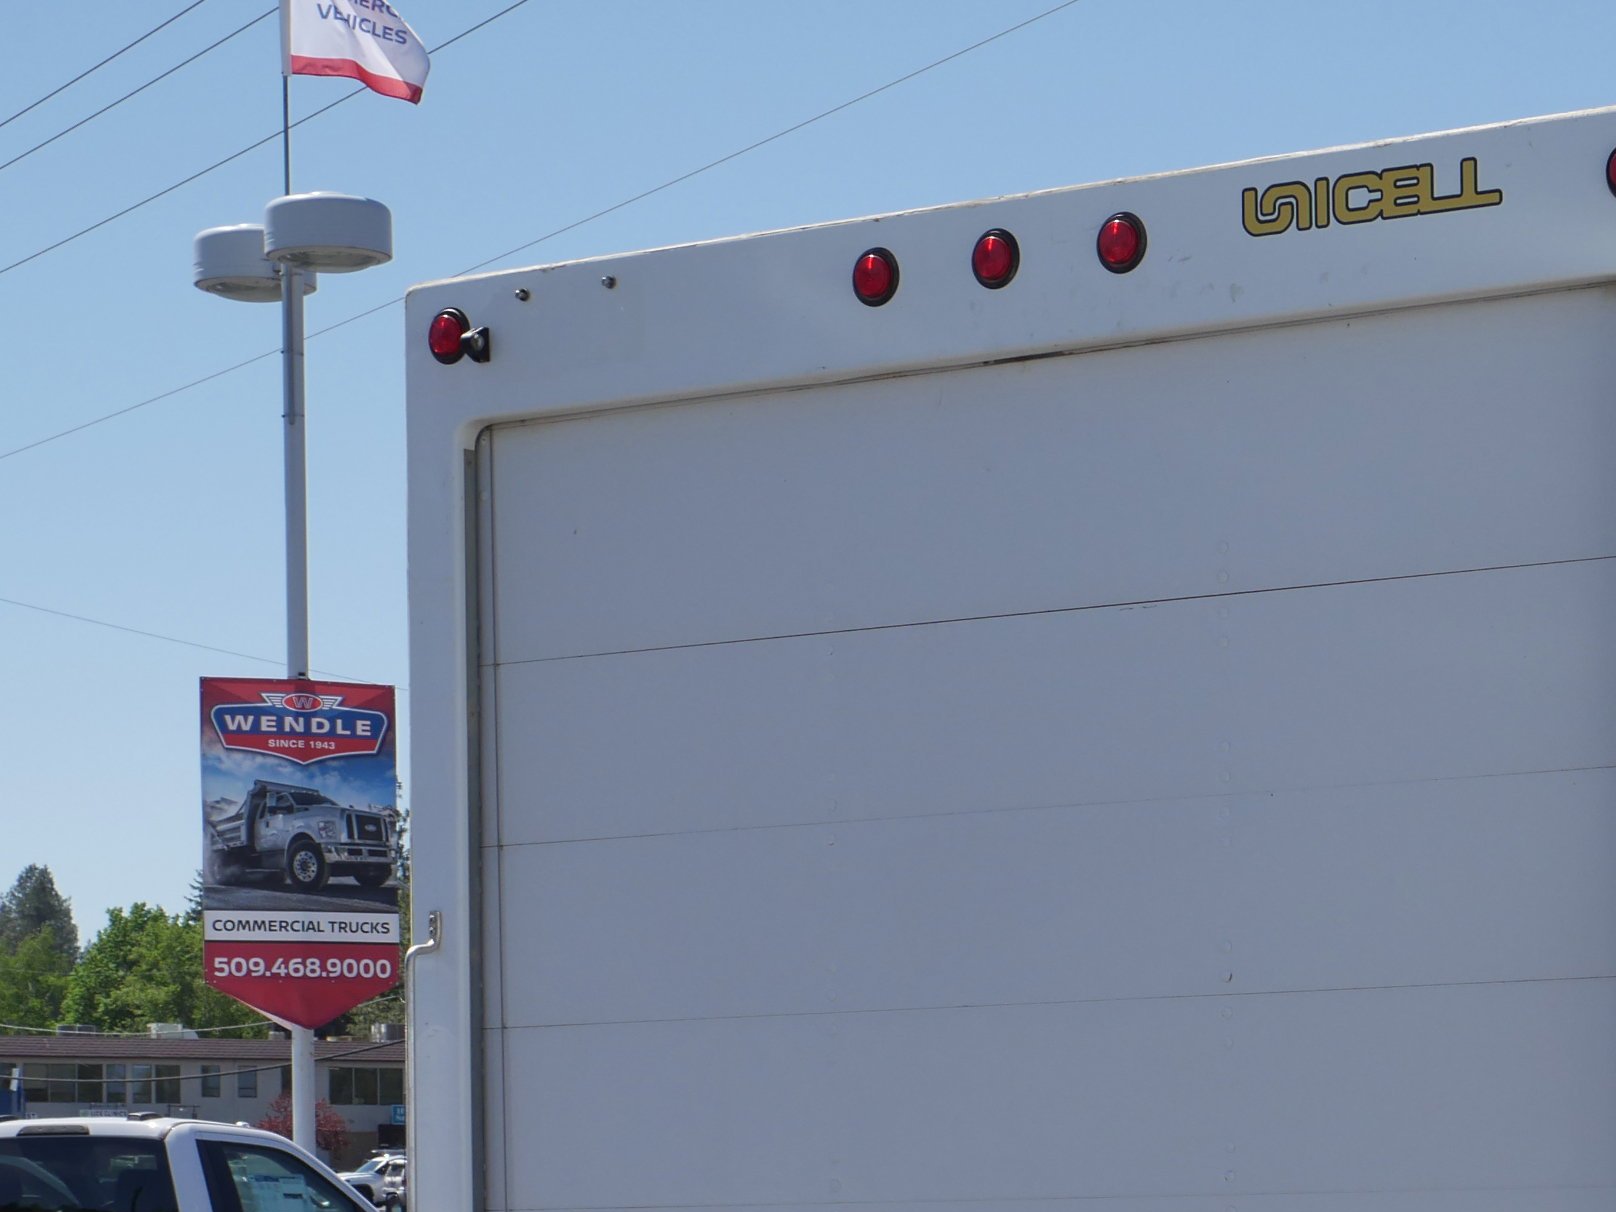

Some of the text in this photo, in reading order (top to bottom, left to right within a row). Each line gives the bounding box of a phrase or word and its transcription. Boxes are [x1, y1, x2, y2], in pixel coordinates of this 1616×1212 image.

[1242, 157, 1503, 237] UNICELL
[224, 714, 371, 736] WENDLE
[268, 739, 336, 750] SINCE 1943
[212, 919, 390, 934] COMMERCIAL TRUCKS
[213, 957, 392, 979] 509.468.9000
